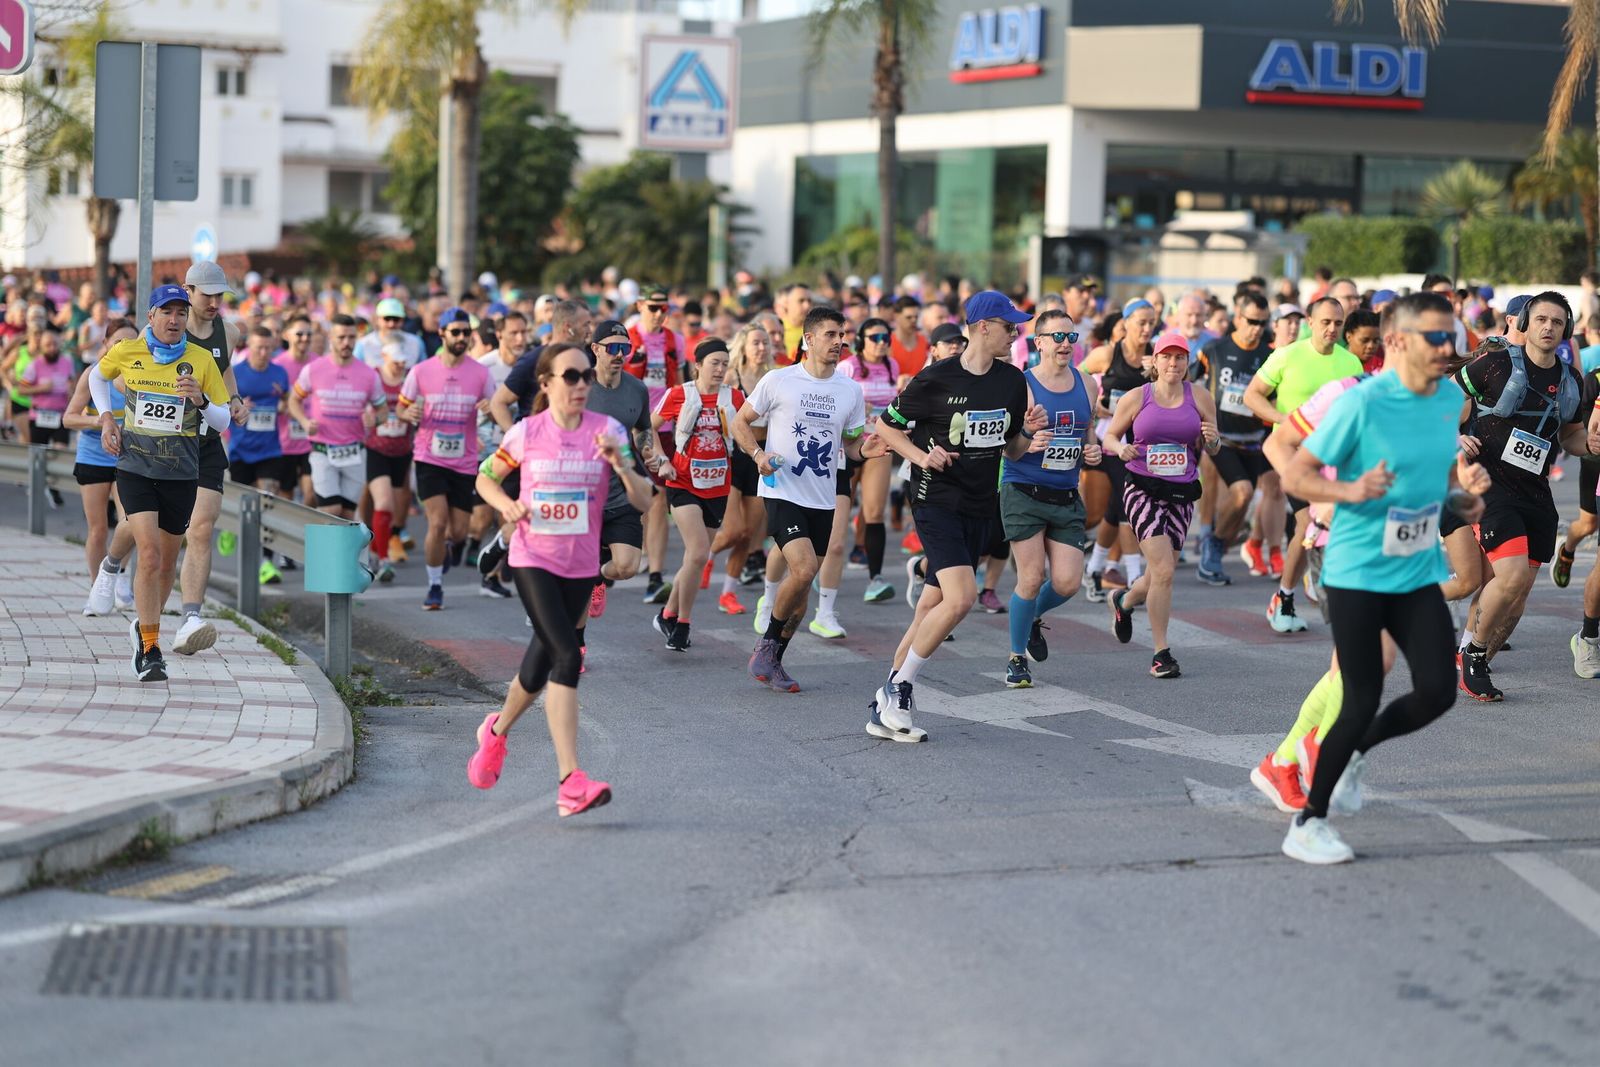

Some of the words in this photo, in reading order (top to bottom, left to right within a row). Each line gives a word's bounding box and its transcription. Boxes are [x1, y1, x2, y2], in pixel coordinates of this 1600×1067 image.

[948, 2, 1044, 69] ALDI
[1250, 38, 1427, 97] ALDI
[138, 379, 161, 387] ARROYO
[809, 393, 835, 404] Media
[947, 397, 968, 405] MAAP
[143, 402, 177, 420] 282
[969, 420, 1005, 436] 1823
[438, 440, 460, 451] 732
[1513, 441, 1542, 461] 884
[1046, 447, 1080, 460] 2240
[1149, 453, 1186, 466] 2239
[692, 467, 725, 480] 2426
[540, 503, 579, 520] 980
